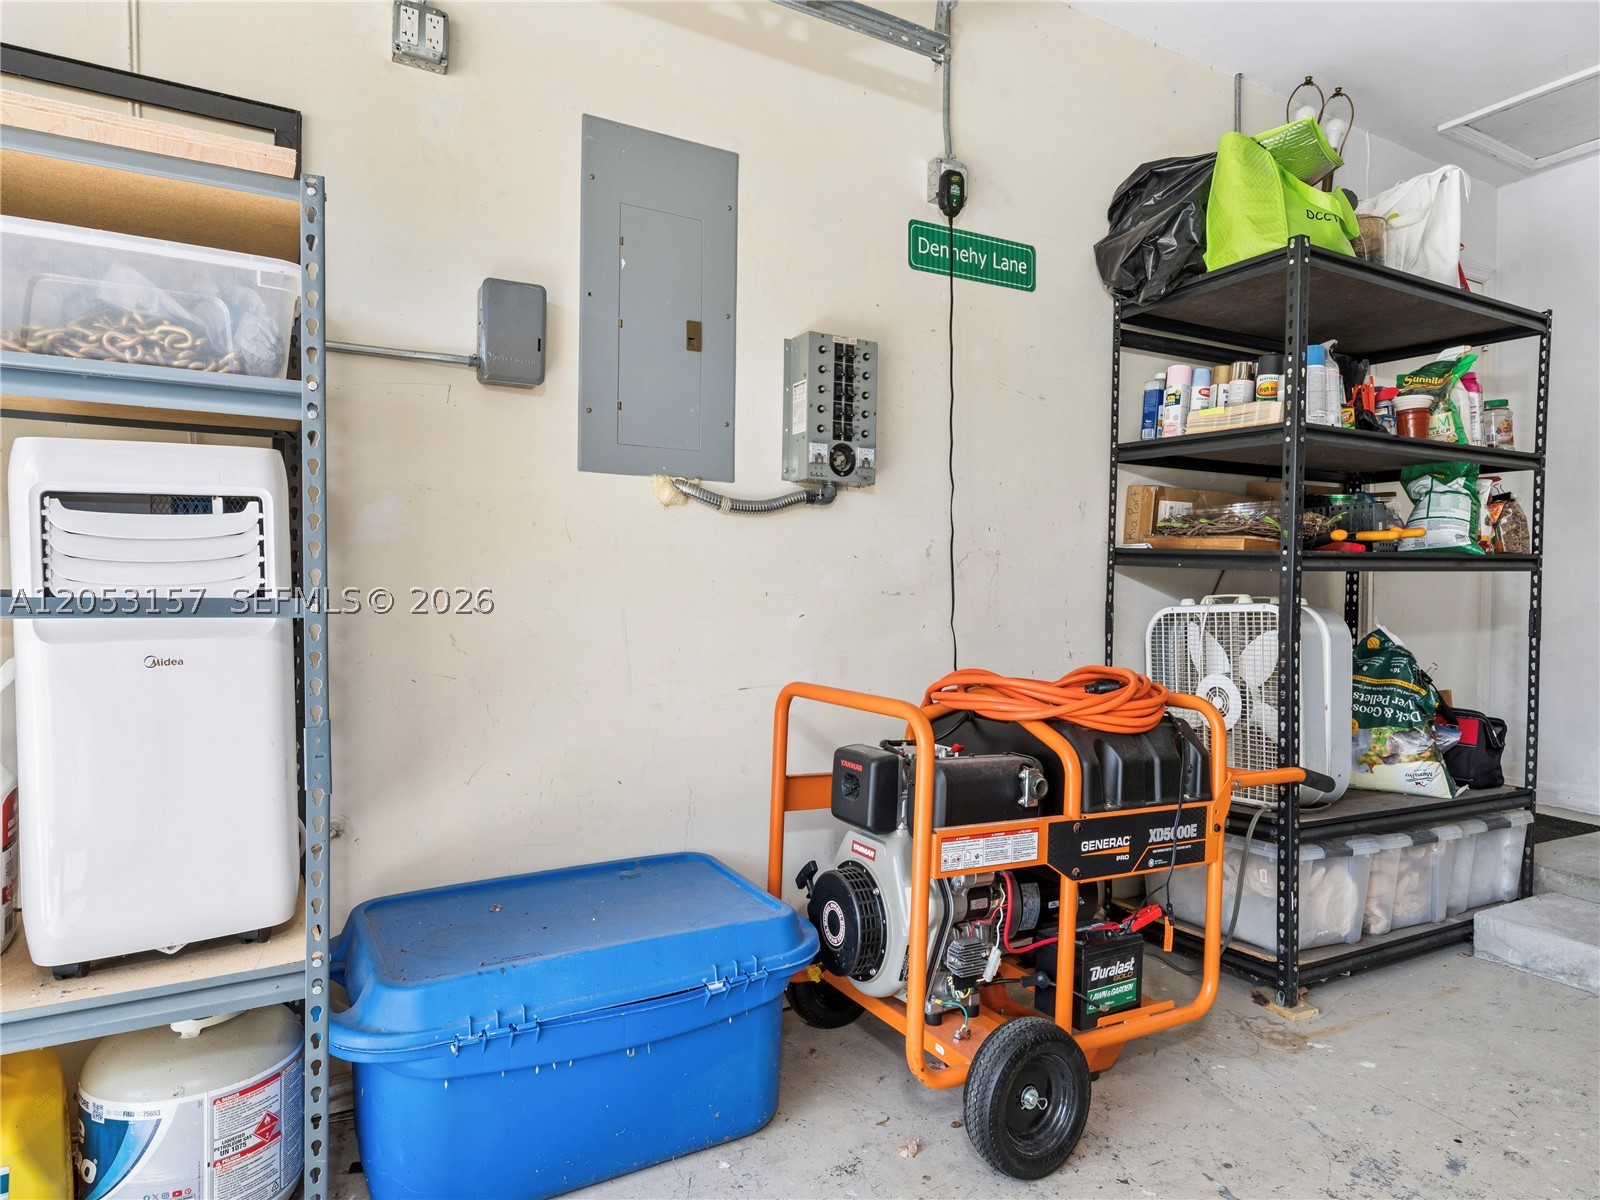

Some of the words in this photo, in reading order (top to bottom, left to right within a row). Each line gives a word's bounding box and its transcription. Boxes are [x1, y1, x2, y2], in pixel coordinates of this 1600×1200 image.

[1306, 209, 1340, 222] DCCT
[918, 236, 987, 270] Dennehy
[993, 252, 1027, 275] Lane
[1402, 374, 1450, 387] Sunnila
[1127, 490, 1140, 516] Part
[1125, 520, 1138, 540] Kia
[144, 654, 184, 669] Midea
[1352, 692, 1391, 706] Pellets
[1352, 704, 1382, 717] Goos
[1383, 707, 1394, 719] &
[1395, 710, 1422, 723] Dck
[840, 759, 863, 772] YANMAR
[853, 842, 875, 857] YANMAR
[1081, 836, 1130, 852] GENERAC
[1089, 957, 1135, 981] Duralast
[1113, 971, 1133, 982] GOLD
[142, 1109, 161, 1117] 75653
[243, 1134, 253, 1142] GAS
[220, 1148, 230, 1156] UN
[231, 1143, 247, 1153] 1075
